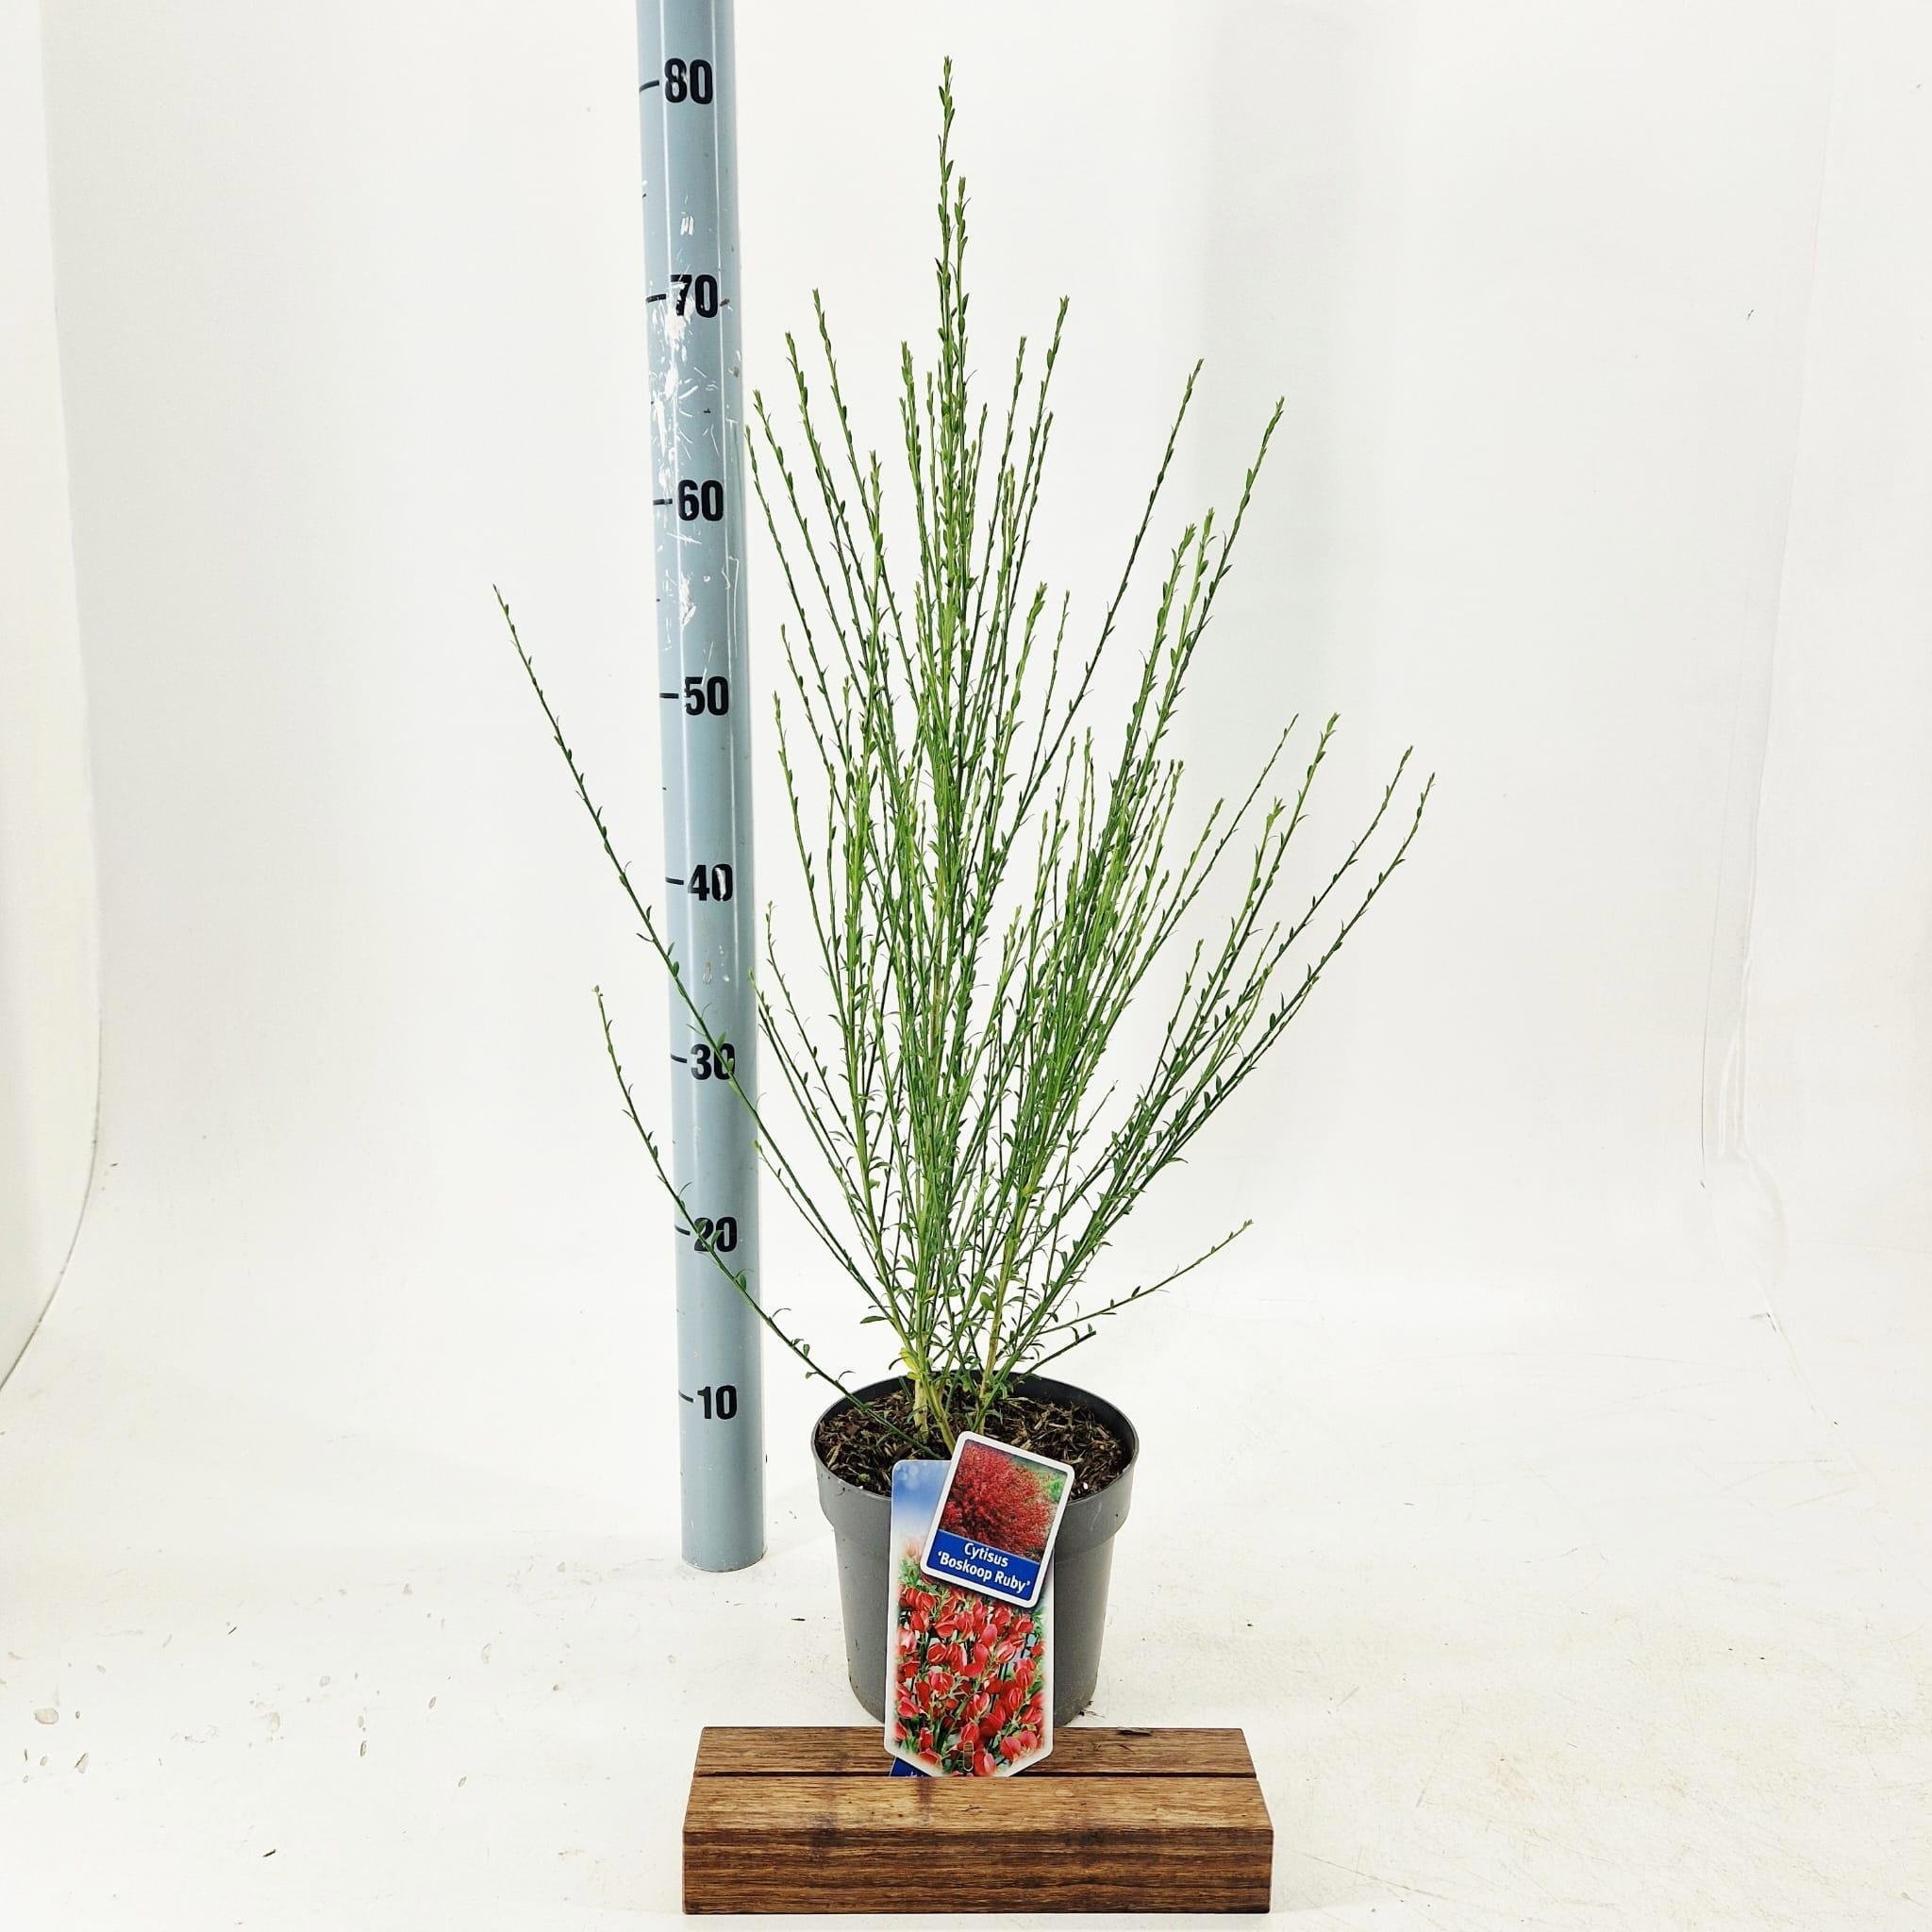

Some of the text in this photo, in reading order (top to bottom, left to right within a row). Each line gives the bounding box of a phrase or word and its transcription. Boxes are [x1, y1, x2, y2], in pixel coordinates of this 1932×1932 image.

[663, 58, 713, 104] 80
[671, 274, 718, 318] 70
[679, 480, 724, 522] 60
[685, 677, 730, 715] 50
[687, 865, 733, 902] 40
[691, 1045, 734, 1080] 30
[694, 1217, 737, 1252] 20
[697, 1386, 737, 1419] 10
[964, 1542, 1008, 1567] Cytisus
